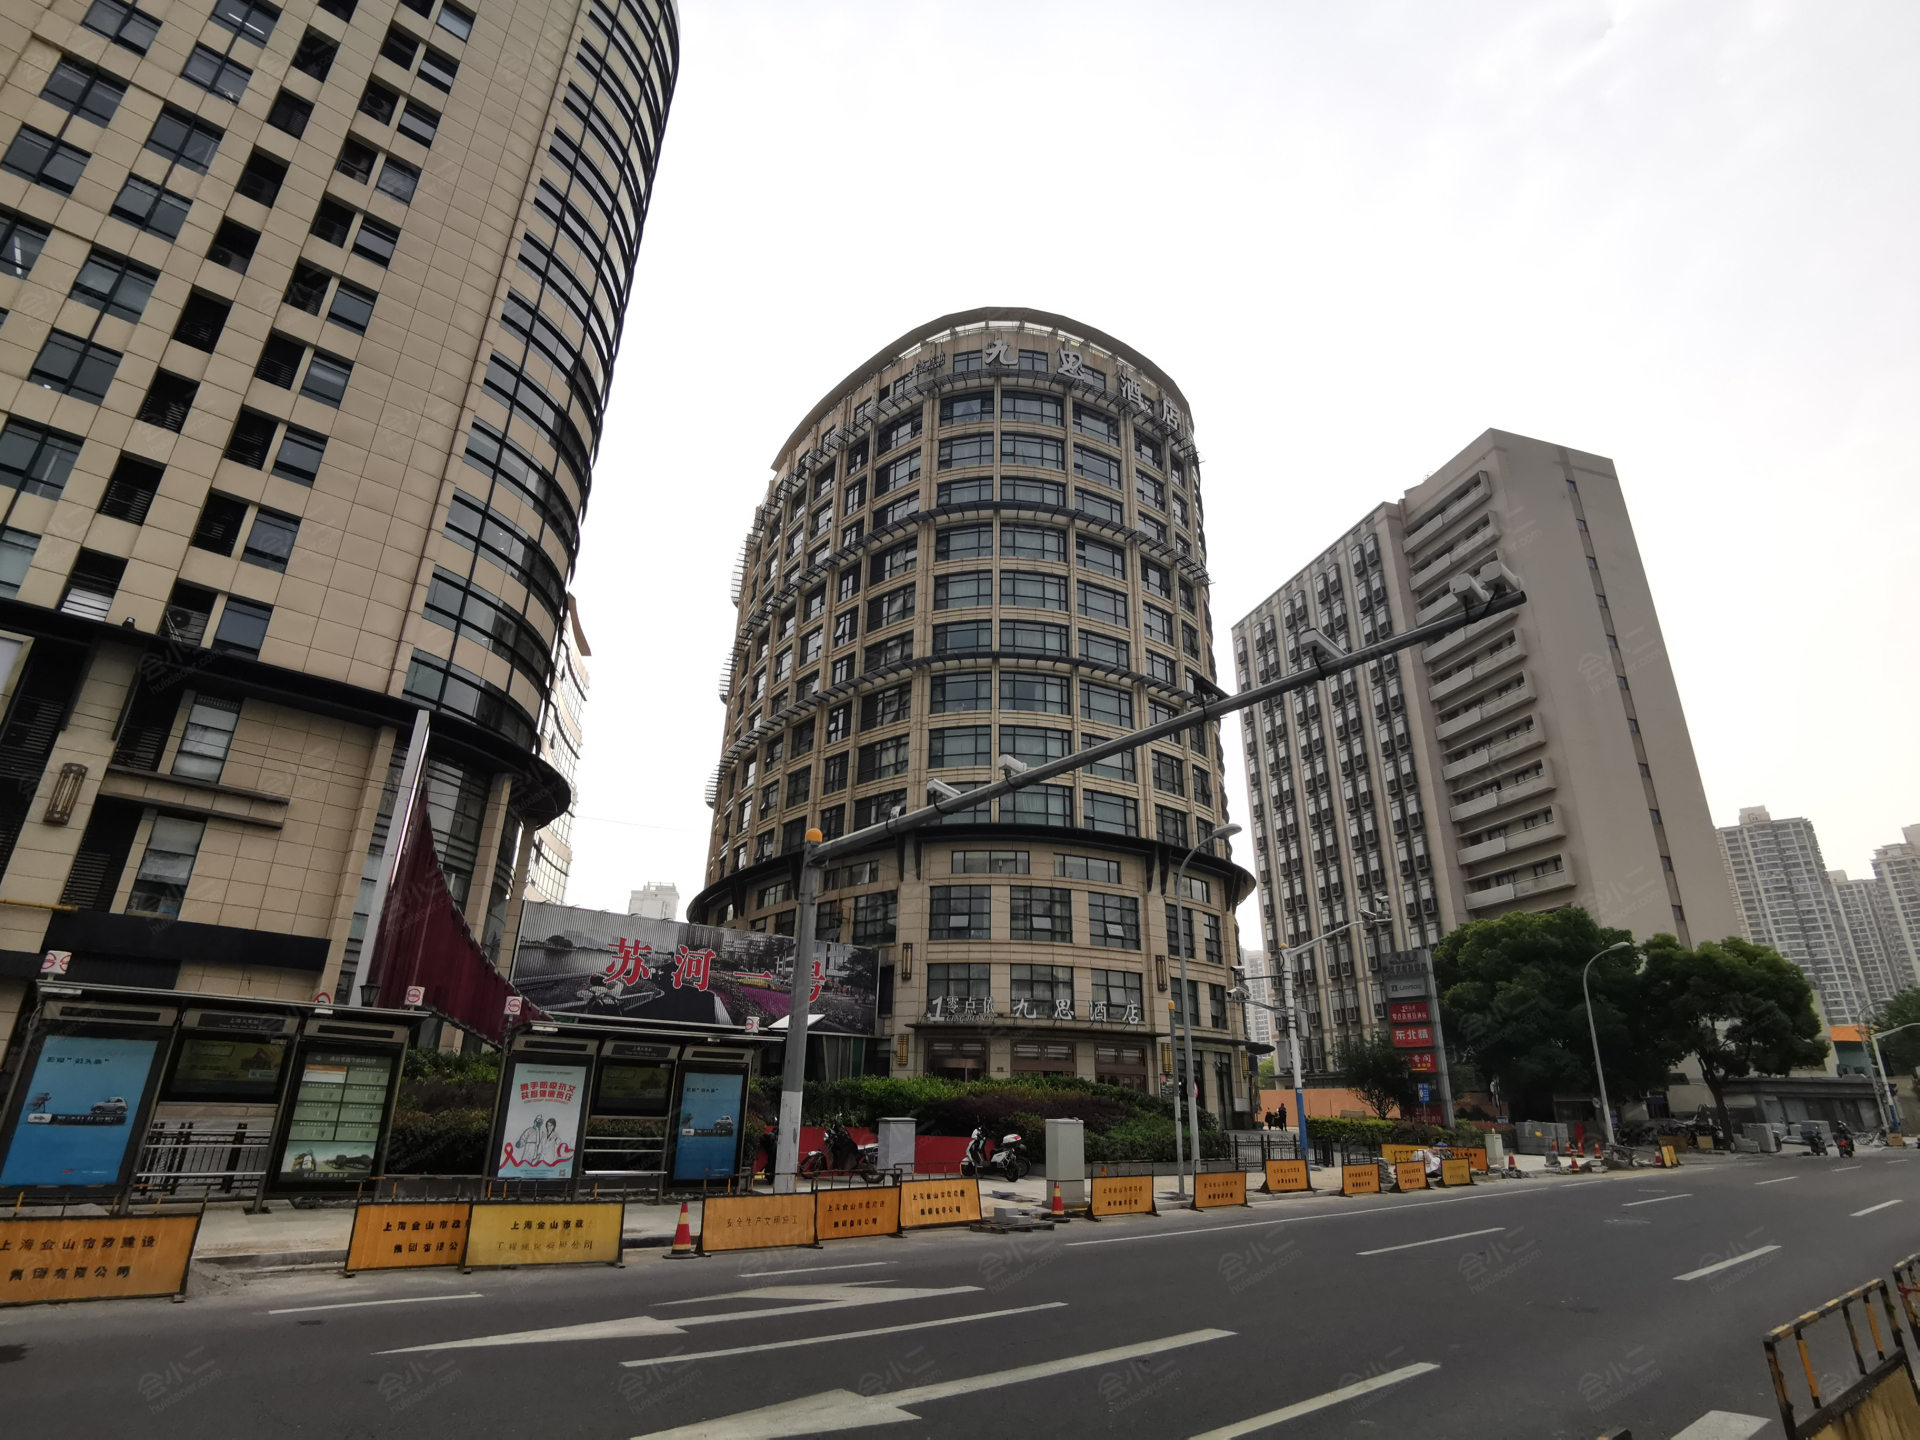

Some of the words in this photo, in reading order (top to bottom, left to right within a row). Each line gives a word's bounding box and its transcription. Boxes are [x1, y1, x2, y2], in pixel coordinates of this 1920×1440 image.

[985, 339, 1180, 431] 九思酒店
[1012, 997, 1141, 1025] 九思酒店
[383, 1219, 469, 1232] 上海金山市政
[0, 1235, 156, 1251] 上海金山市政建设
[9, 1265, 132, 1282] 集团有限公司
